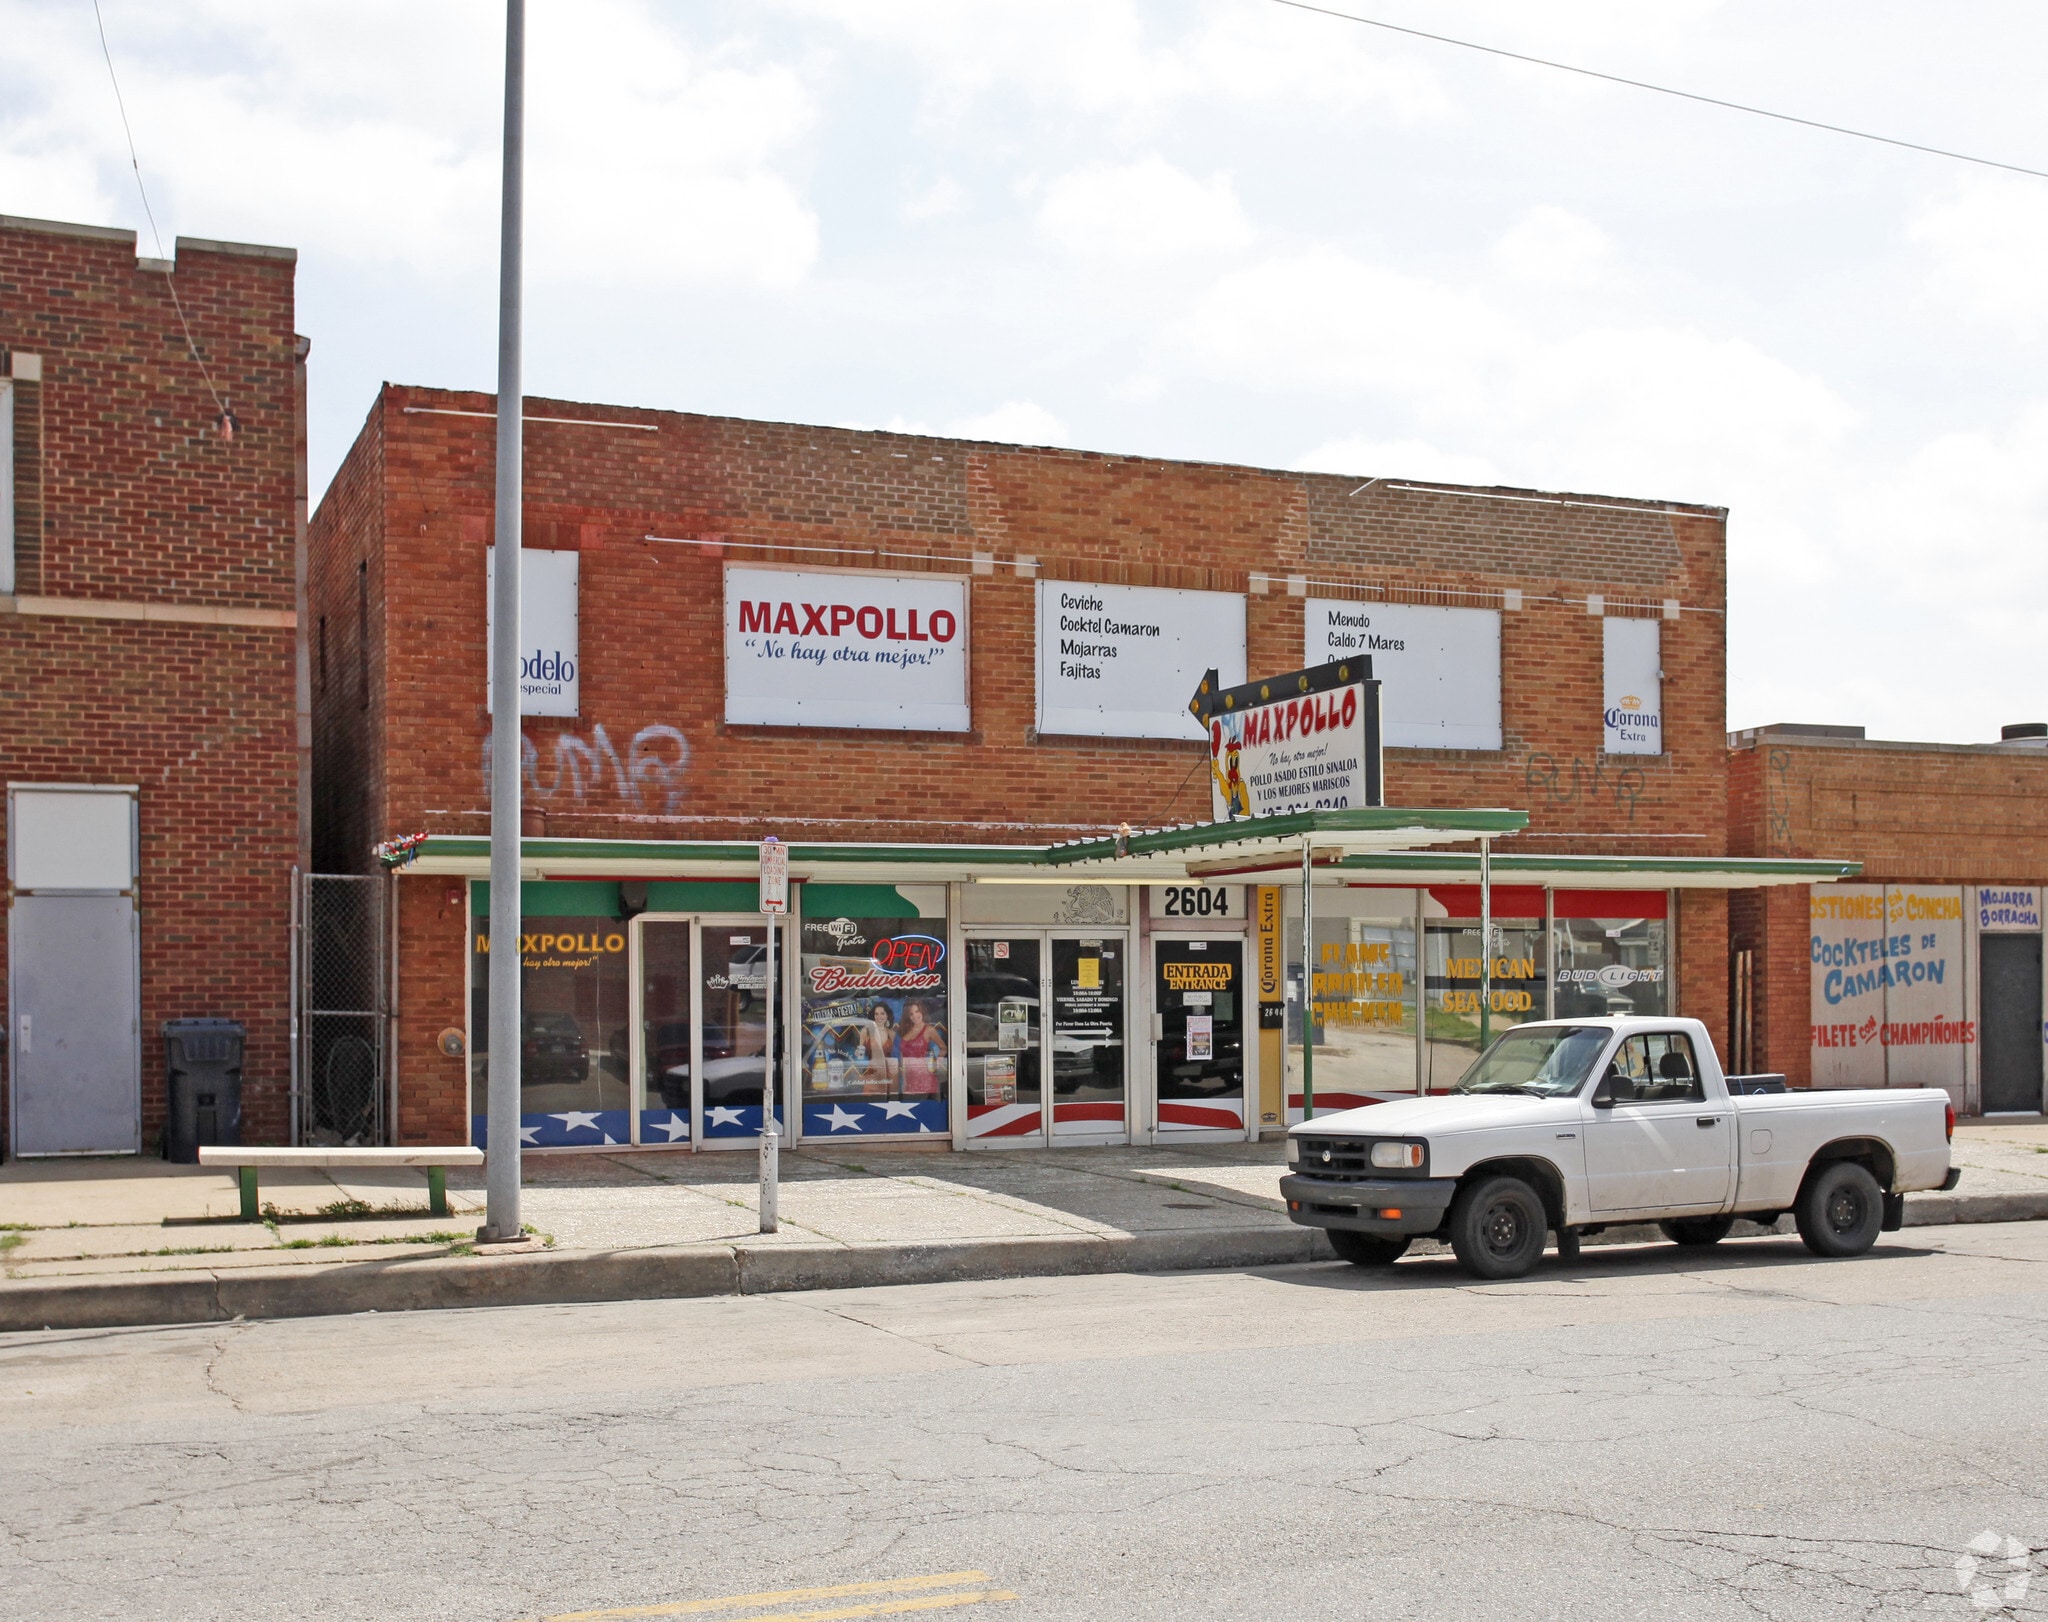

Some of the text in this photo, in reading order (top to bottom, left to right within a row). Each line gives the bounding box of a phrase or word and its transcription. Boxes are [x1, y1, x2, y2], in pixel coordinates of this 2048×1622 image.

[1061, 593, 1103, 611] Ceviche
[739, 600, 957, 643] MAXPOLLO
[1060, 615, 1160, 637] Cocktel Camaron
[1328, 610, 1370, 628] Menudo
[1060, 639, 1117, 658] Mojarras
[1328, 631, 1405, 651] Caldo 7 Mares
[791, 641, 828, 666] hay
[832, 648, 871, 663] otra
[1060, 661, 1101, 680] Fajitas
[520, 683, 562, 695] special
[1243, 686, 1358, 750] MAXPOLLO
[1604, 708, 1659, 731] Corona
[1620, 729, 1646, 742] Extra
[1250, 758, 1358, 787] POLLO ASADO ESTILO SINALOA
[1257, 775, 1350, 801] Y LOS MEJORES MARISCOS
[1165, 887, 1229, 916] 2604
[1811, 888, 1962, 924] OSTIONES EN SU CONCHA
[1979, 888, 2033, 908] MOJARRA
[804, 923, 828, 931] FREE
[1980, 909, 2038, 928] BORRACHA
[475, 933, 626, 954] MXPOLLO
[872, 938, 941, 970] OPEN
[1260, 892, 1276, 993] Corona Extra
[1811, 934, 1936, 967] COCKTELES DE
[1321, 944, 1391, 969] FLAME
[809, 965, 942, 993] Budweiser
[1166, 964, 1230, 979] ENTRADA
[1558, 969, 1664, 982] BUD LIGHT
[1824, 959, 1945, 1005] CAMARON
[1169, 979, 1227, 990] ENTRANCE
[1312, 973, 1403, 998] BROILED
[1443, 991, 1533, 1013] SEAOOD
[1311, 1002, 1403, 1029] CHICKEN
[1811, 1014, 1976, 1047] FILETE CON CHAMPIÑONES
